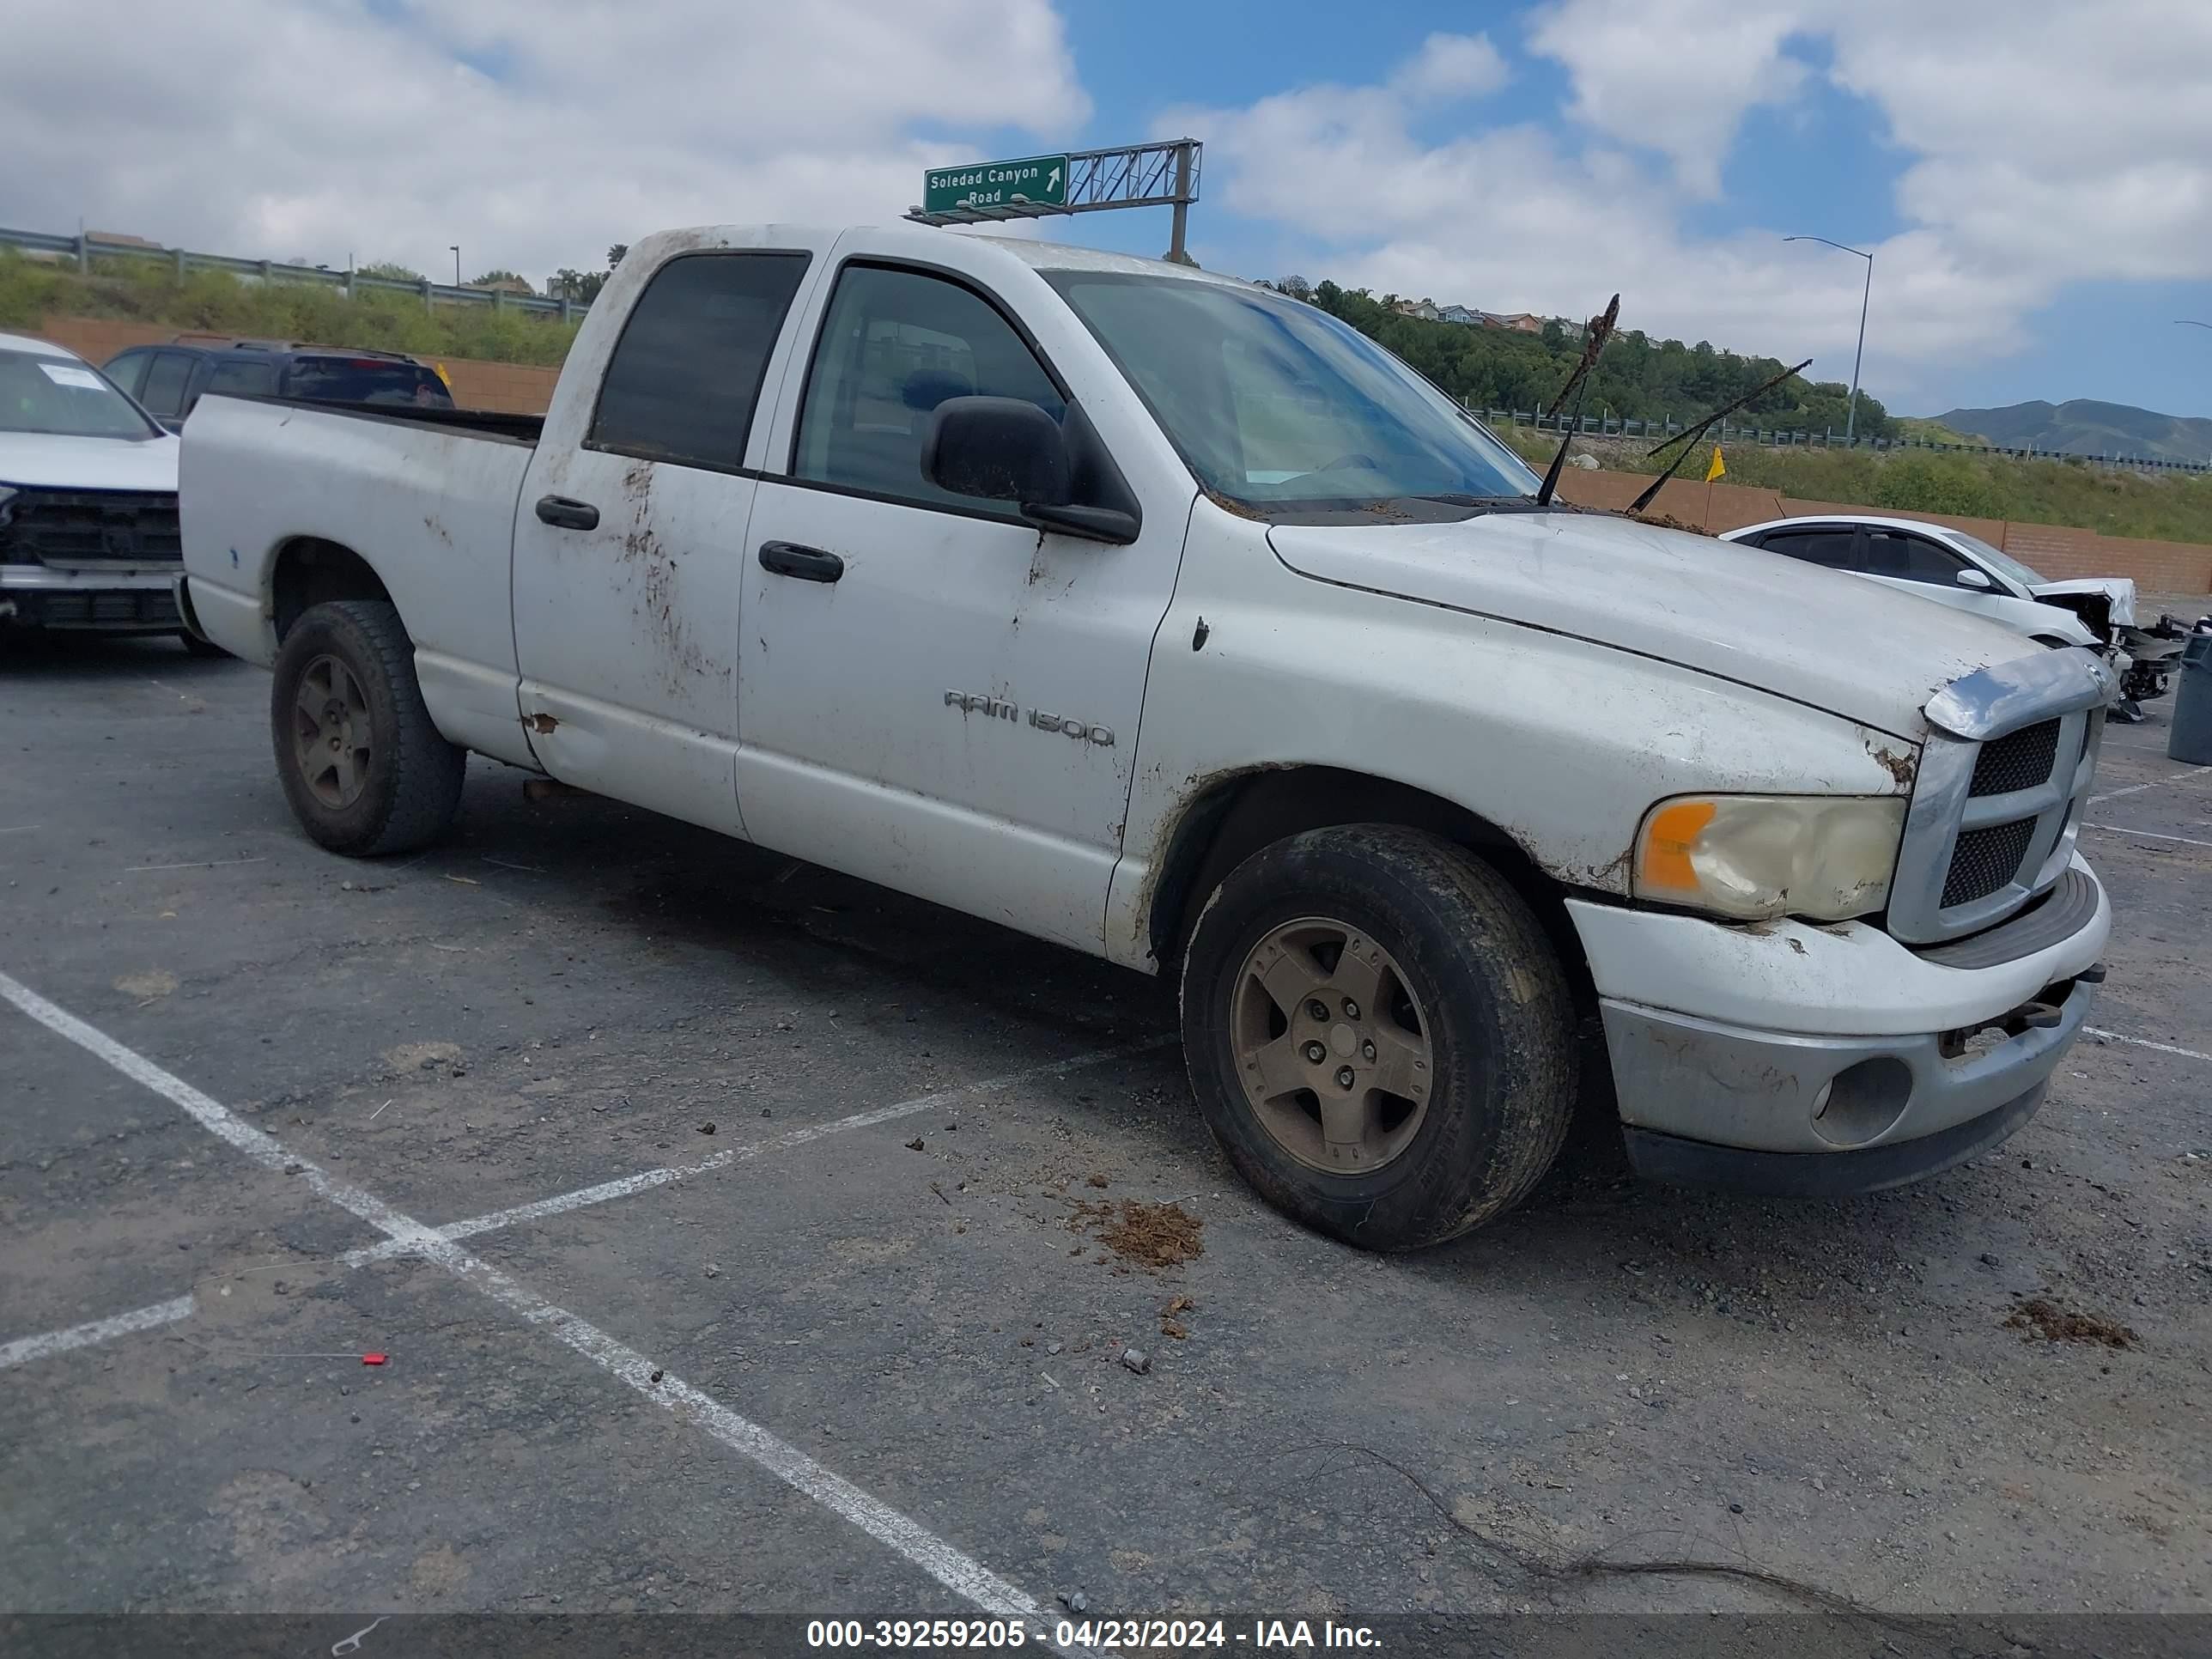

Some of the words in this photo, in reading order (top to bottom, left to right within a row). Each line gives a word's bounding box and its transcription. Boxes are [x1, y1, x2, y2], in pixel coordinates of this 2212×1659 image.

[931, 172, 982, 189] Soledad
[988, 167, 1038, 185] Canyon
[969, 189, 1001, 204] Road
[945, 688, 1018, 722] RAM
[1026, 707, 1115, 746] 1500
